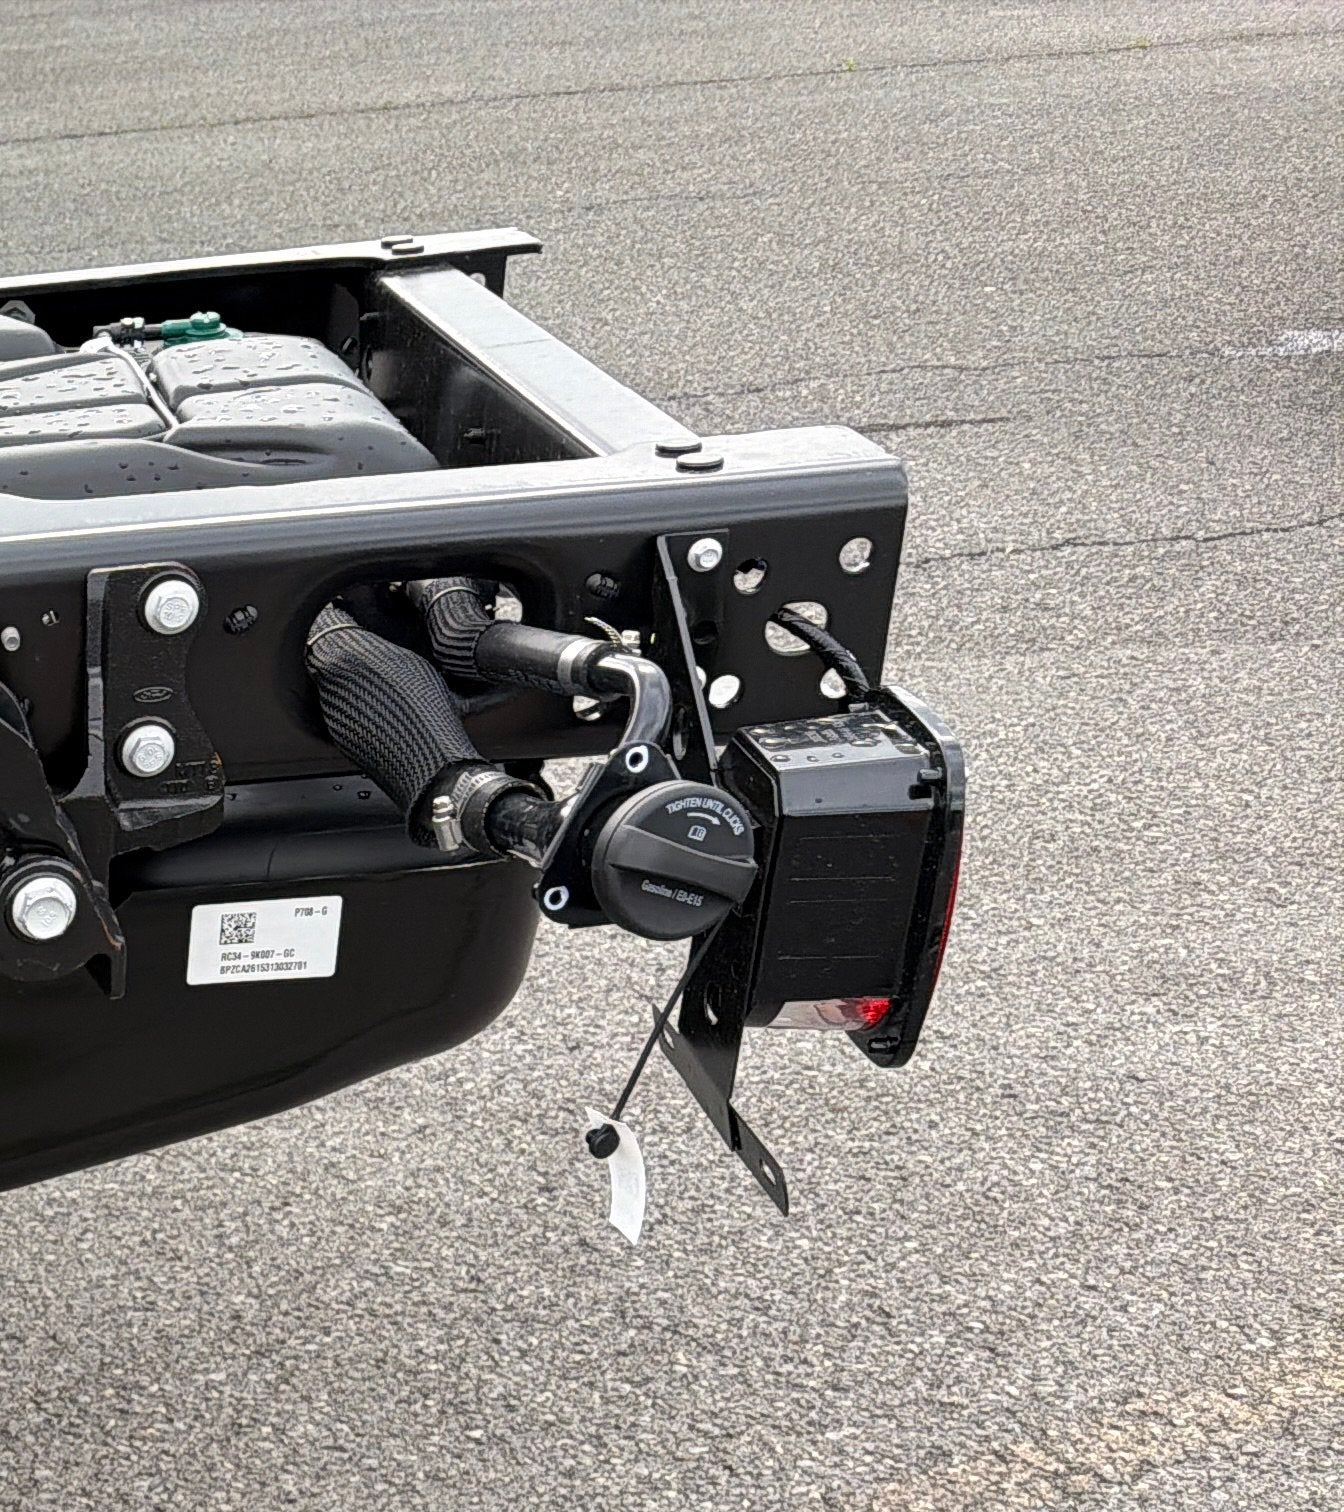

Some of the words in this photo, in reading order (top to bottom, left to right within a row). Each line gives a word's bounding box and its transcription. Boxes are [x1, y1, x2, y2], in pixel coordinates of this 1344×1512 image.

[665, 797, 703, 815] TIGHTEN
[702, 797, 724, 815] UNTIL
[722, 808, 745, 836] CLICKS
